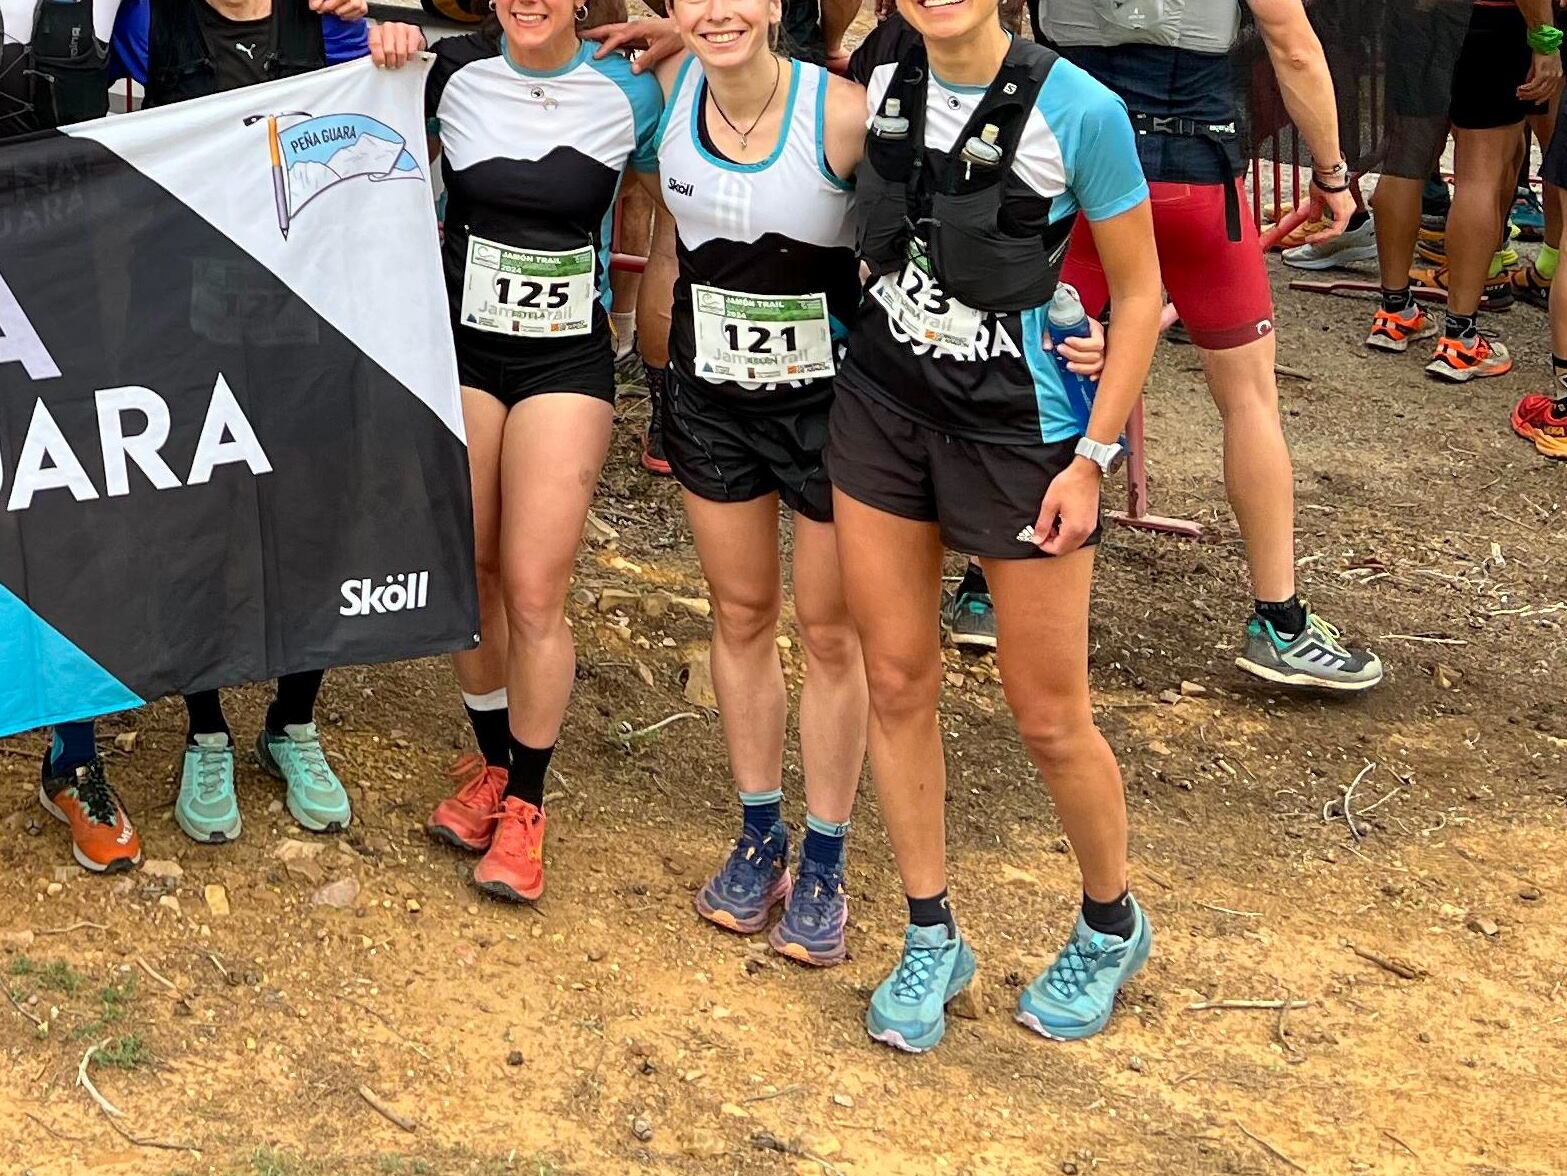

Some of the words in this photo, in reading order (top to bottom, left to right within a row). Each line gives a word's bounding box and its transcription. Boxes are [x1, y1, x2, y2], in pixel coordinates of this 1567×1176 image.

[290, 129, 321, 154] PEÑA
[322, 125, 357, 143] GUARA
[668, 177, 694, 197] Sköll
[500, 265, 522, 274] 2024
[535, 256, 562, 265] TRAIL
[496, 277, 570, 309] 125
[757, 300, 785, 309] TRAIL
[725, 324, 797, 354] 121
[339, 571, 429, 616] Sköll
